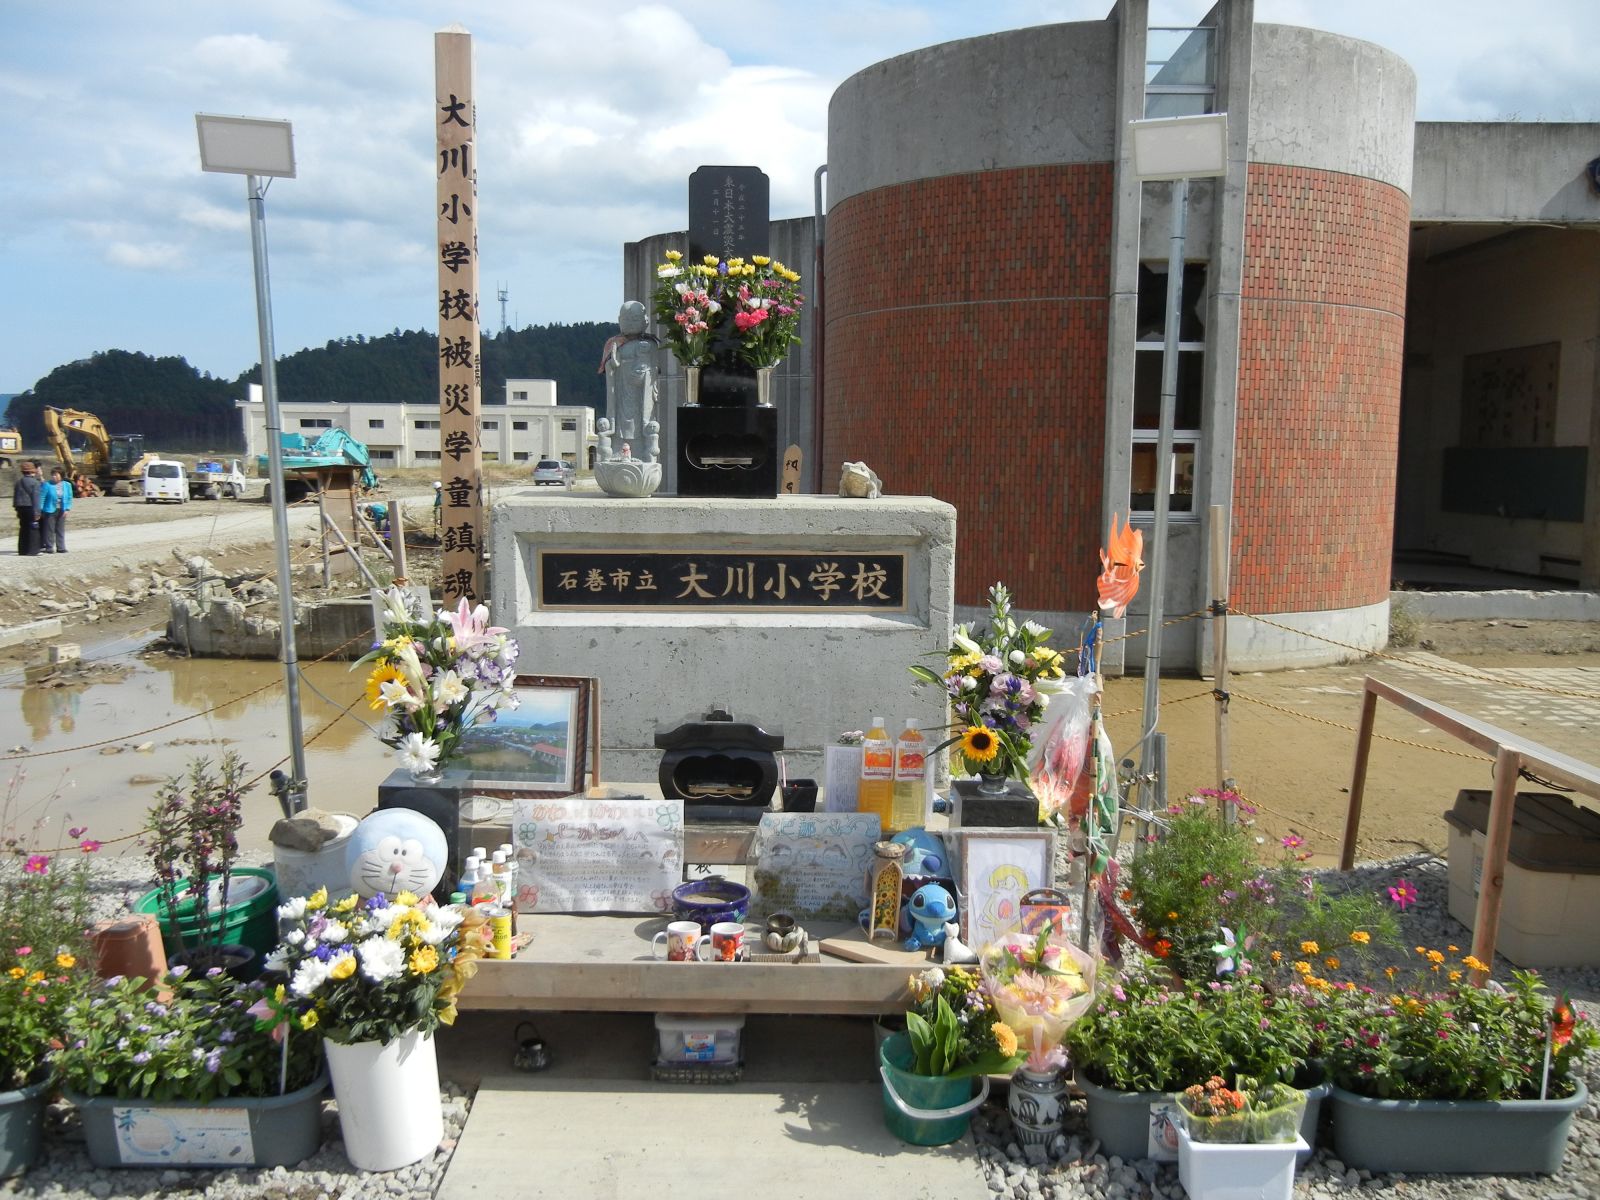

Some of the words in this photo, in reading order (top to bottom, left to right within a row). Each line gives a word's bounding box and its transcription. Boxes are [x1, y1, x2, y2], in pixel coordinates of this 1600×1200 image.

[712, 190, 720, 235] 三月十一日
[439, 94, 476, 600] 大川小学校被災学童鎮魂
[557, 568, 658, 592] 石巻市立
[675, 562, 891, 600] 大川小学校
